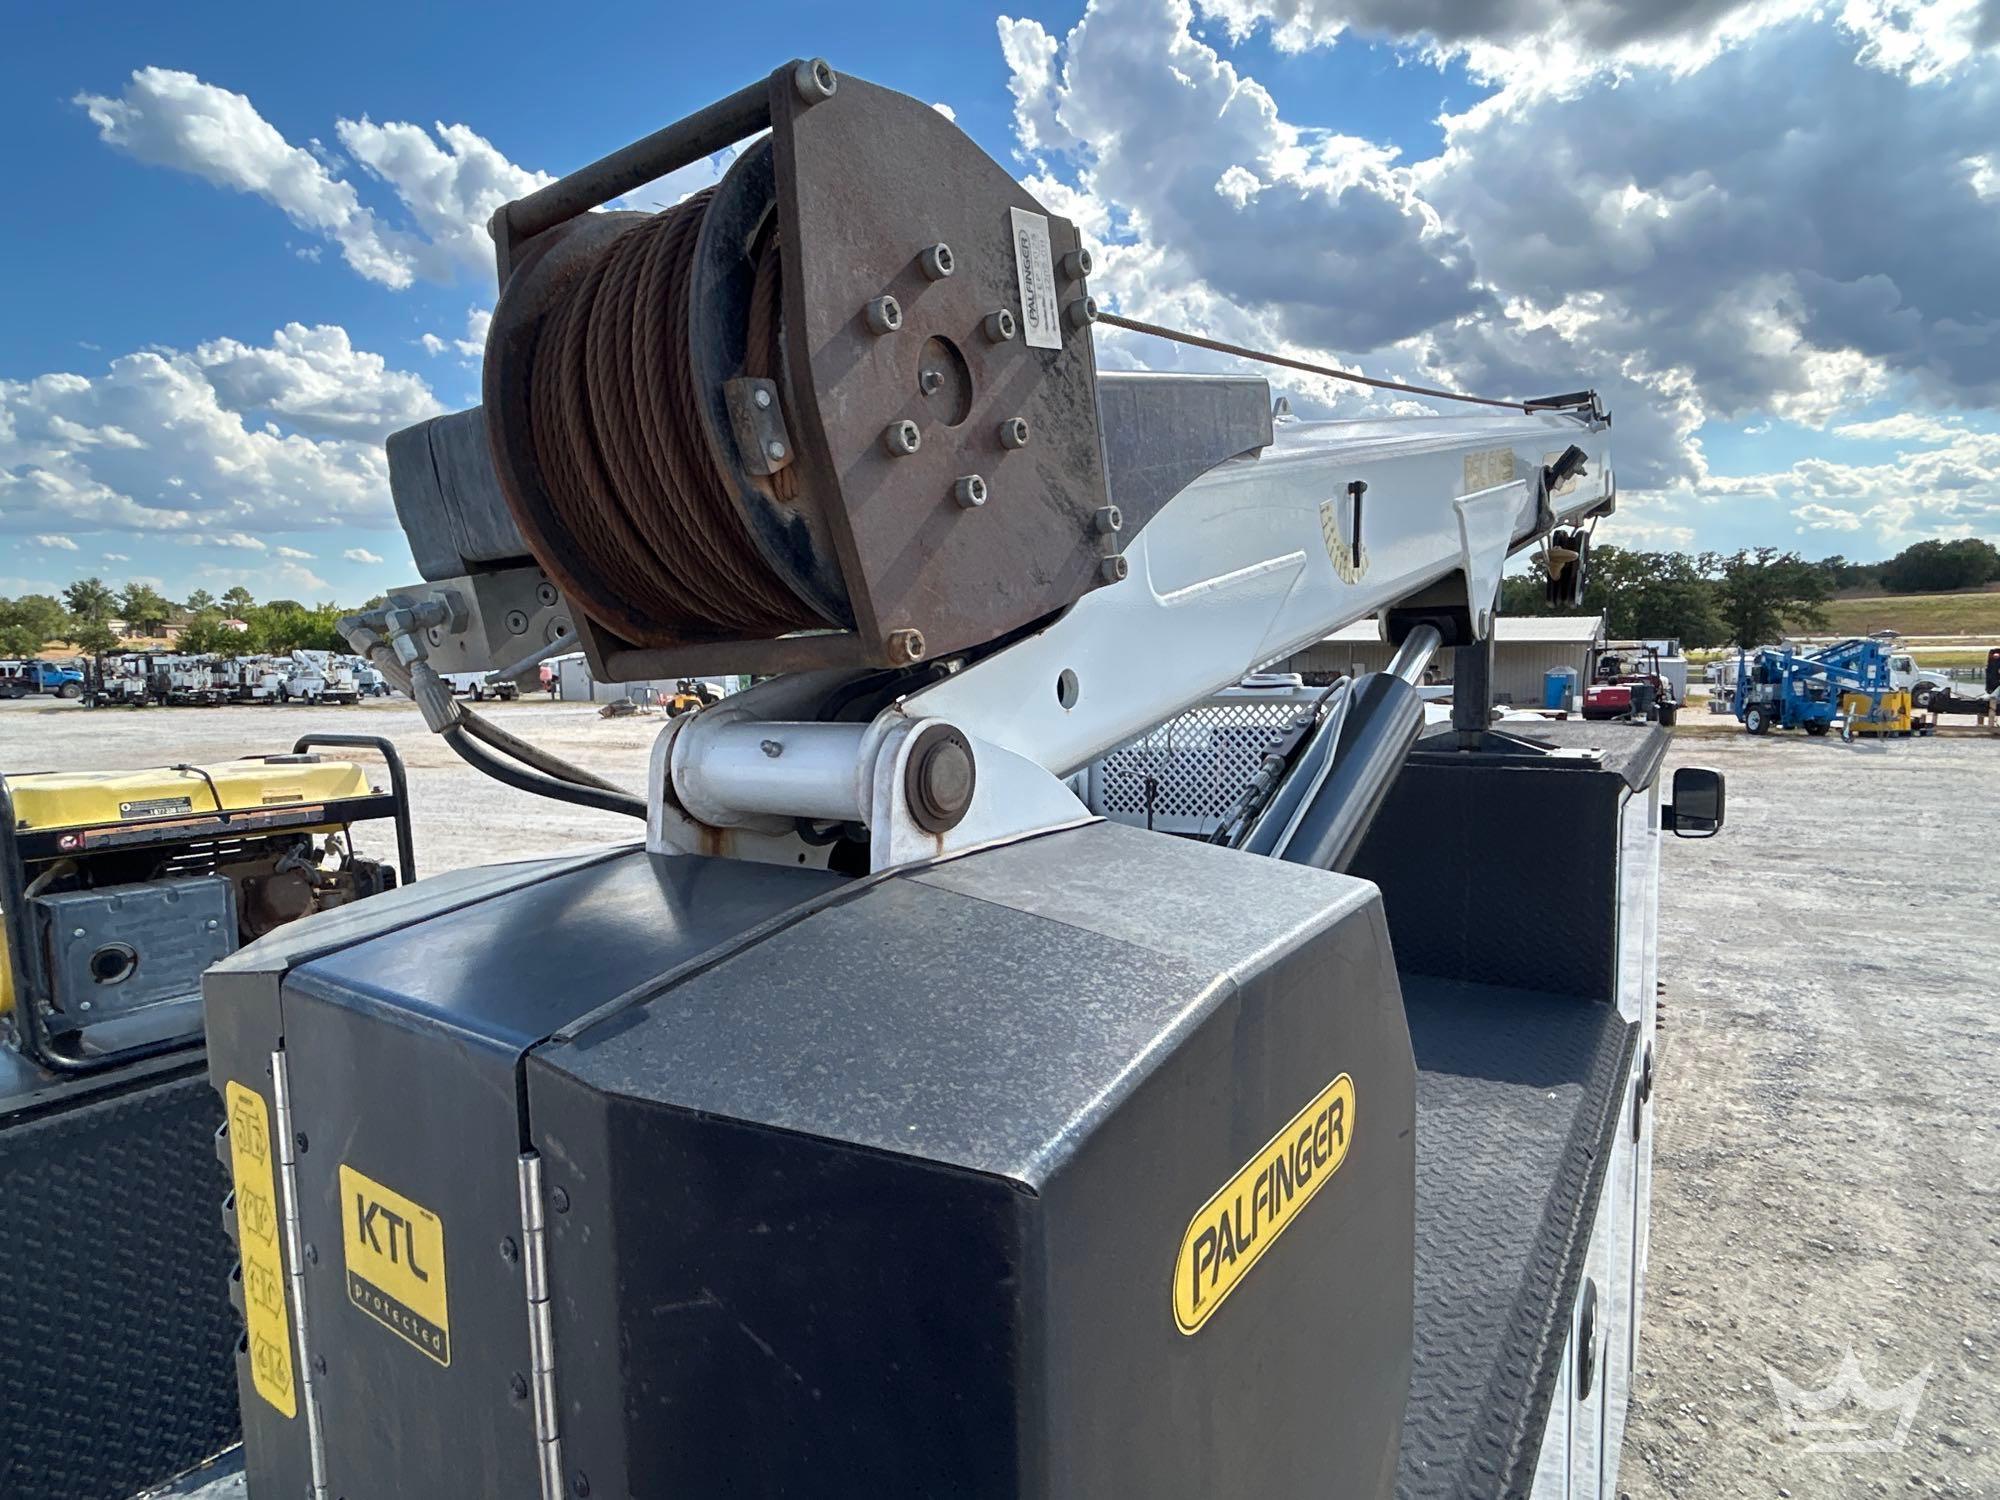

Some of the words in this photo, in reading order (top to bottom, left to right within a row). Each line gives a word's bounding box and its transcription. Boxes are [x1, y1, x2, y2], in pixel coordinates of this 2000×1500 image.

[1020, 237, 1037, 321] PALFINGER
[357, 1193, 428, 1282] KTL
[1192, 1096, 1345, 1306] PALFINGER
[355, 1284, 441, 1351] protected
